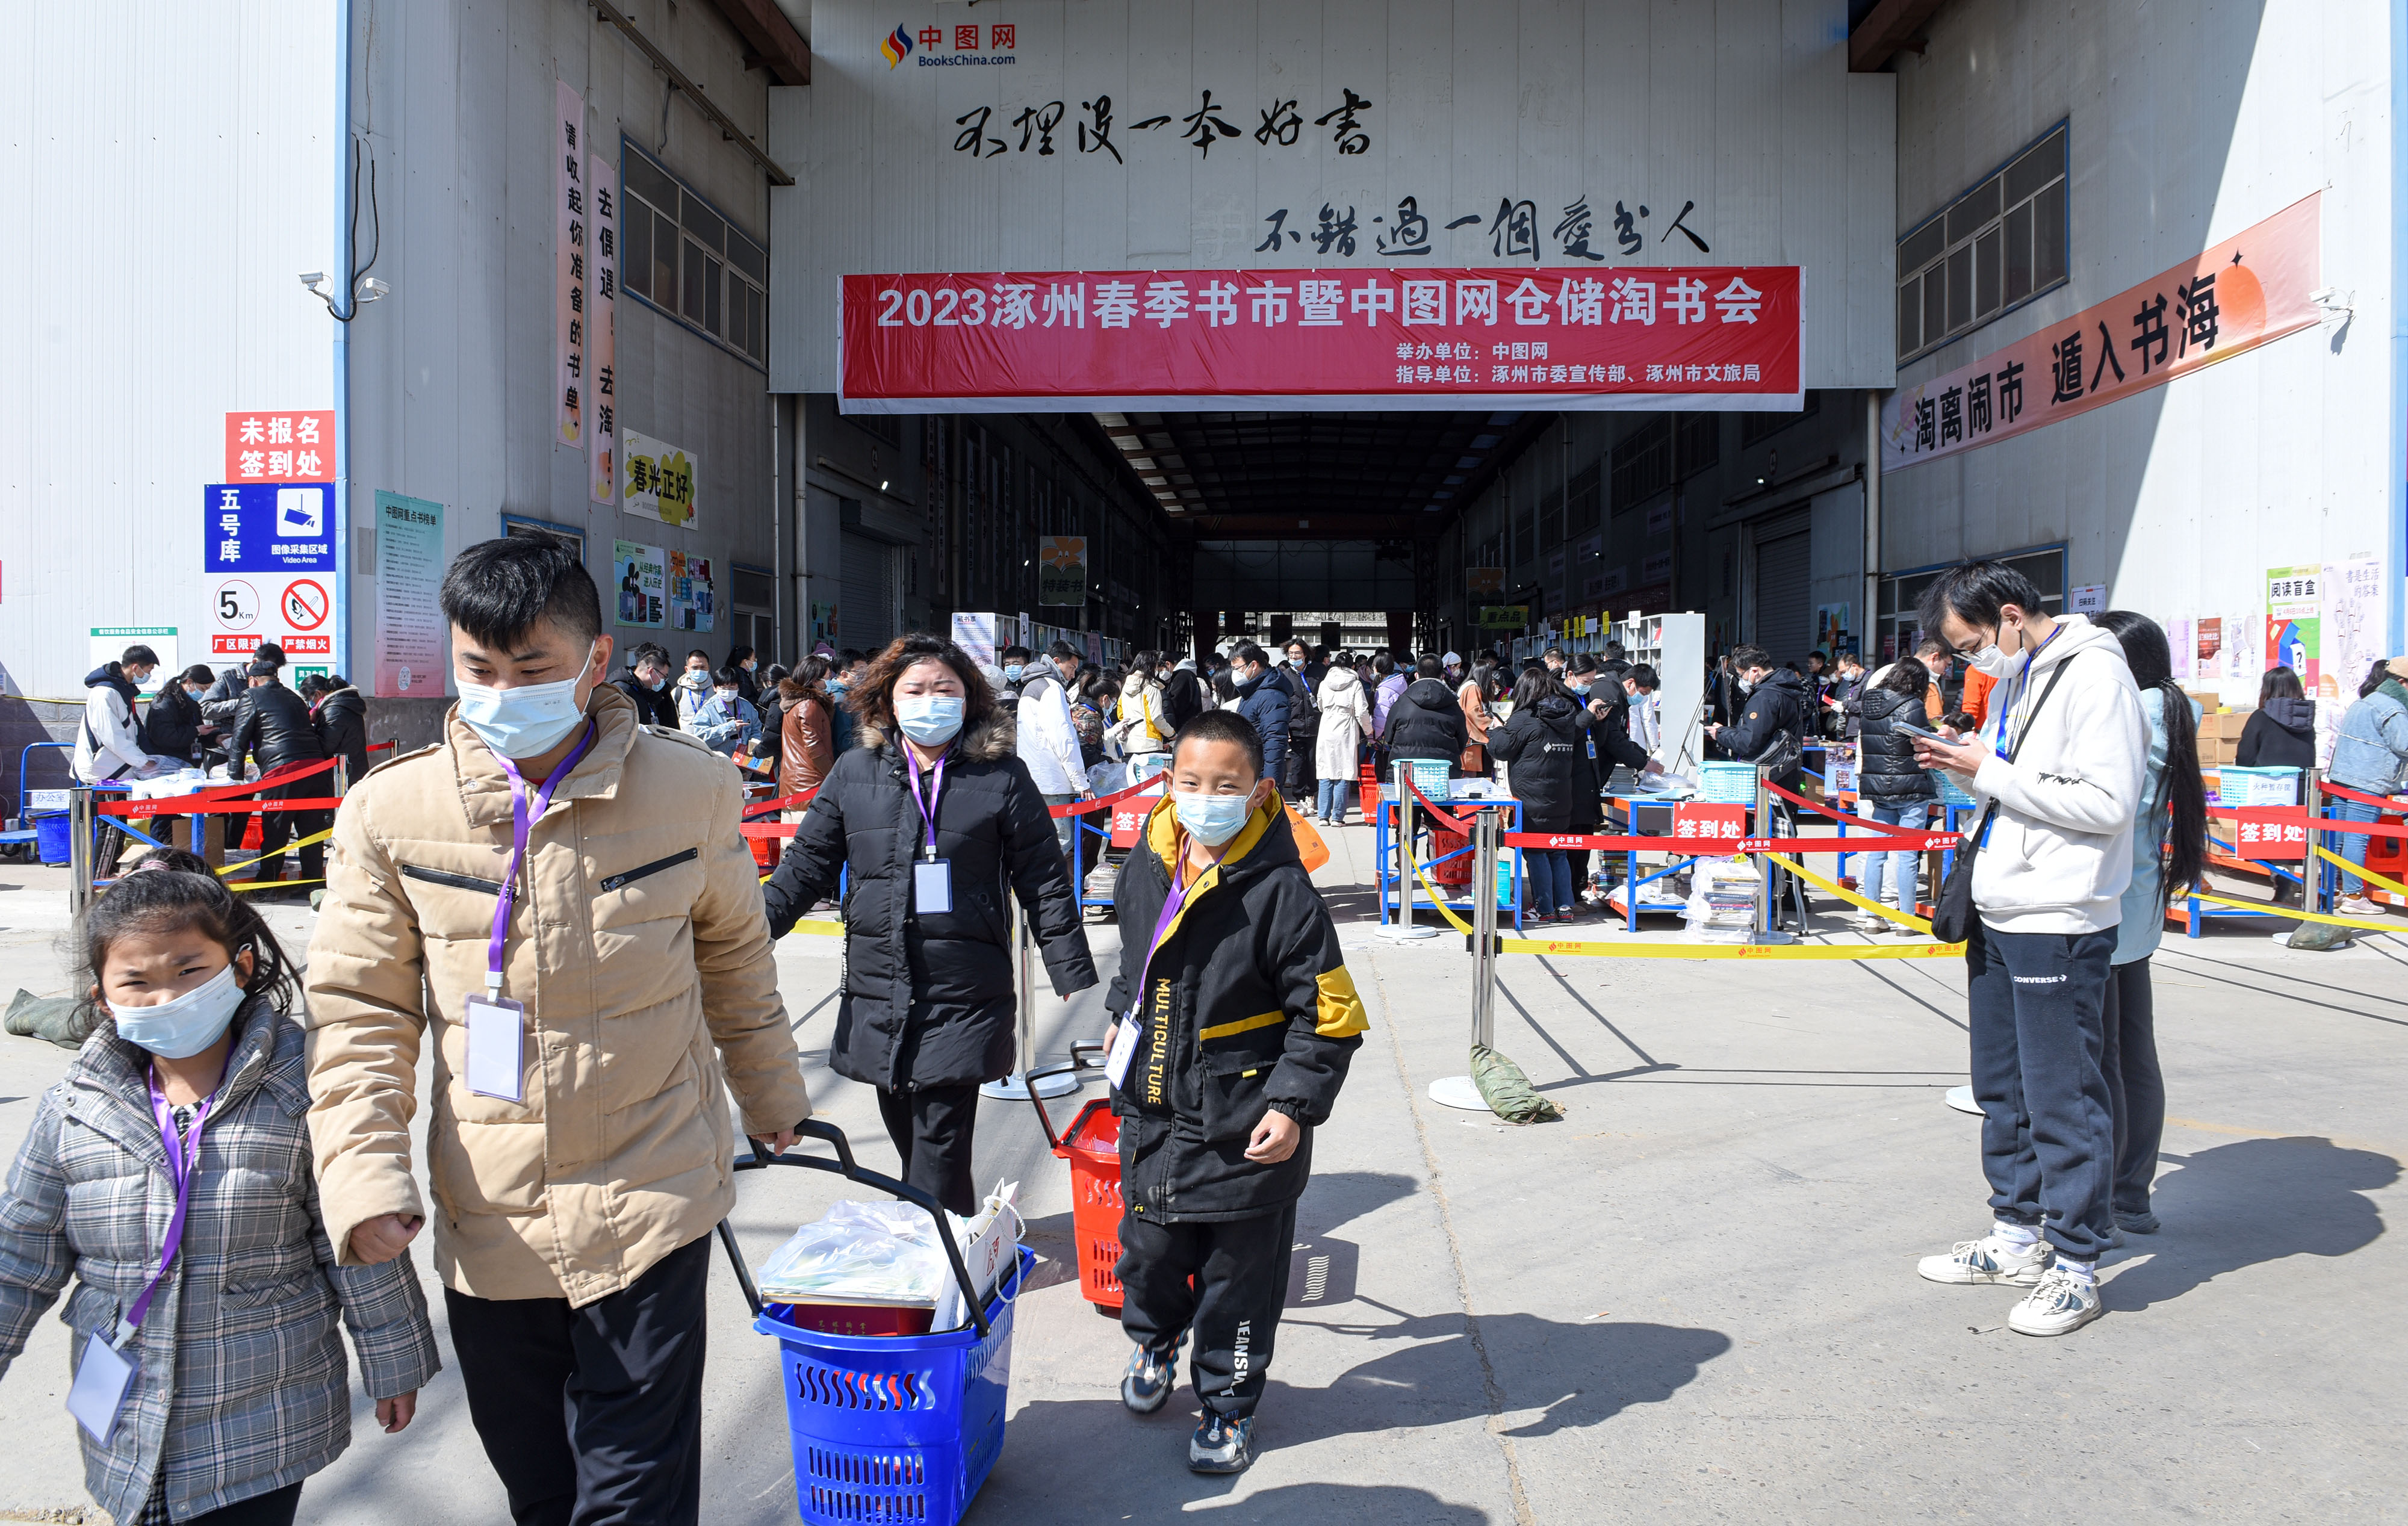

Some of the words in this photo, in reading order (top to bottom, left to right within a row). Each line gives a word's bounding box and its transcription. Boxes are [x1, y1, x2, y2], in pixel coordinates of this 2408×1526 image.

[919, 25, 1016, 51] 中图网
[919, 55, 1016, 66] BooksChina.com
[565, 120, 583, 411] 请收起你准备的书单
[878, 276, 1763, 330] 2023涿州春季书市暨中图网仓储淘书会
[1914, 361, 2025, 453] 淘离闹市
[2050, 272, 2220, 406] 遁入书海
[239, 417, 320, 445] 未报名
[239, 450, 322, 477] 签到处
[634, 459, 688, 504] 春光正好
[220, 489, 241, 562] 五号库
[386, 504, 437, 527] 中图网重点书榜单
[271, 544, 328, 555] 图像采集区域
[1042, 578, 1084, 593] 特装书
[2271, 579, 2315, 598] 阅读盲盒
[220, 591, 238, 619] 5
[1488, 611, 1521, 623] 重点品
[214, 638, 261, 650] 厂区限速
[285, 639, 327, 650] 严禁烟火
[36, 793, 66, 802] 办公室
[1116, 812, 1149, 831] 签到
[1677, 817, 1741, 839] 签到处
[2240, 823, 2304, 843] 签到处
[1147, 978, 1171, 1106] MULTICULTURE
